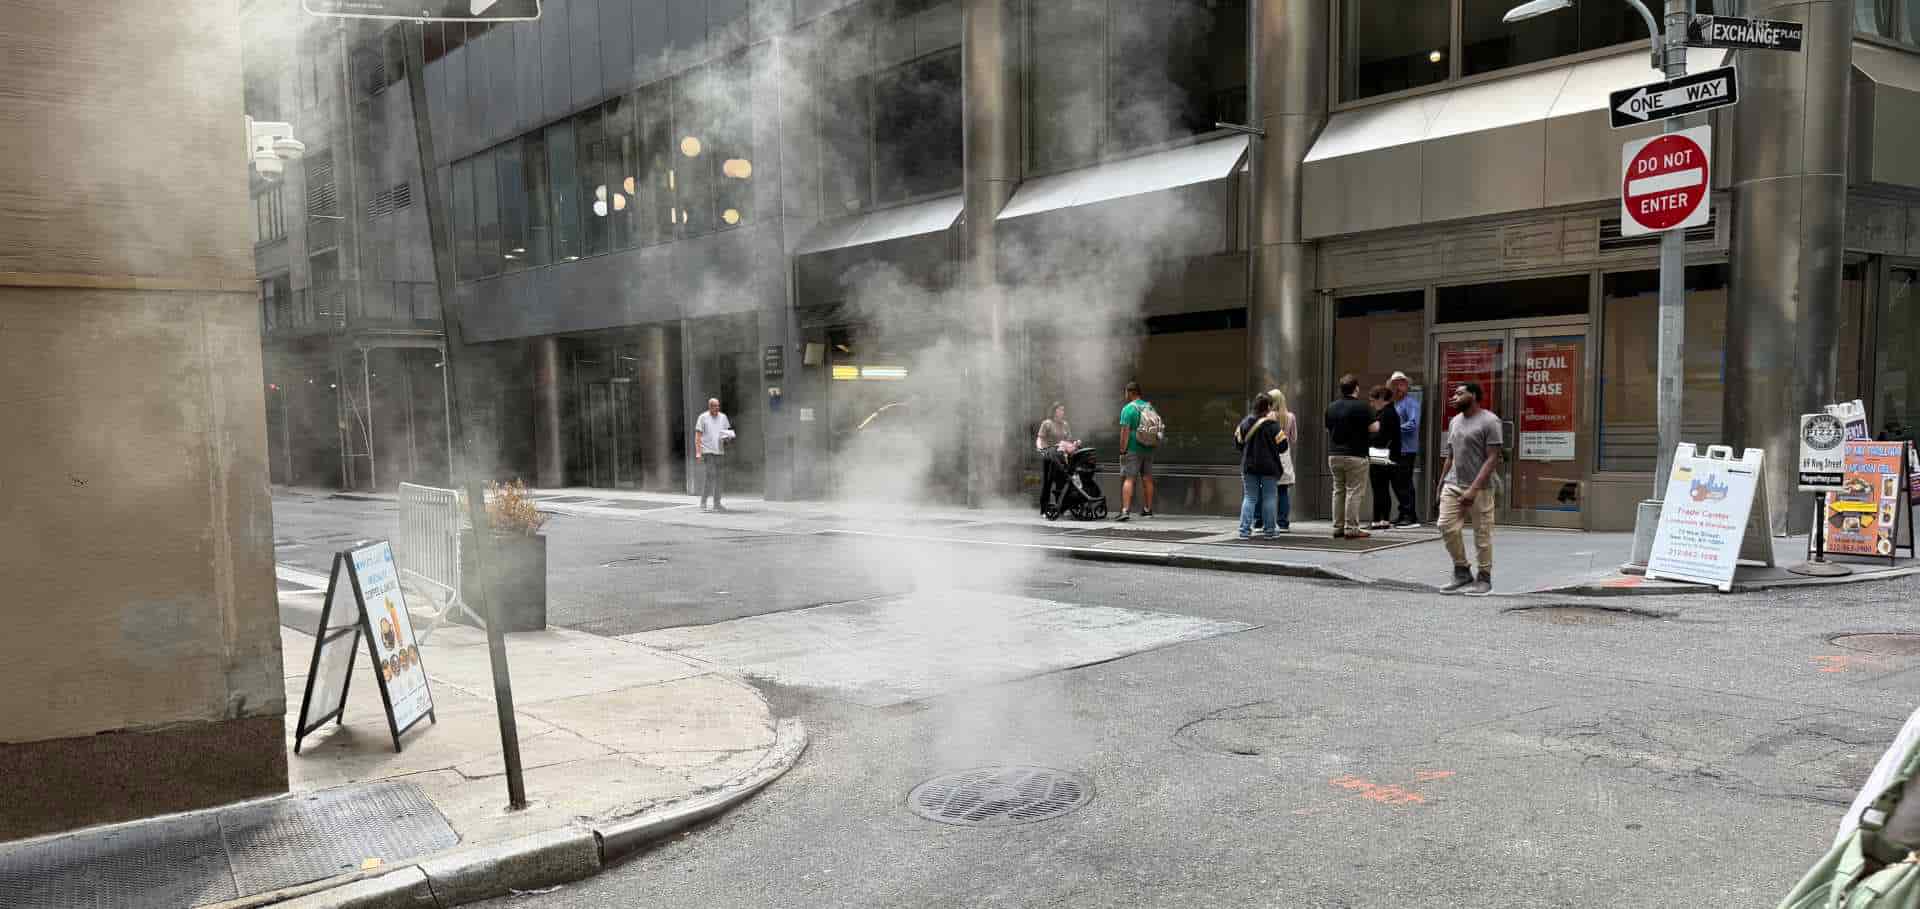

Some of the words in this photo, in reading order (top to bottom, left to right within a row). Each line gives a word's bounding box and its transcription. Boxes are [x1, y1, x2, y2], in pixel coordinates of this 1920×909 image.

[1713, 23, 1780, 45] EXCHANGE
[1780, 29, 1801, 40] PLACE
[1630, 94, 1664, 113] ONE
[1686, 81, 1721, 101] WAY
[1638, 156, 1658, 174] DO
[1663, 150, 1693, 168] NOT
[1640, 193, 1689, 214] ENTER
[1526, 356, 1568, 369] RETAIL
[1526, 370, 1550, 382] FOR
[1526, 383, 1563, 396] LEASE
[1807, 429, 1842, 437] PIZZA
